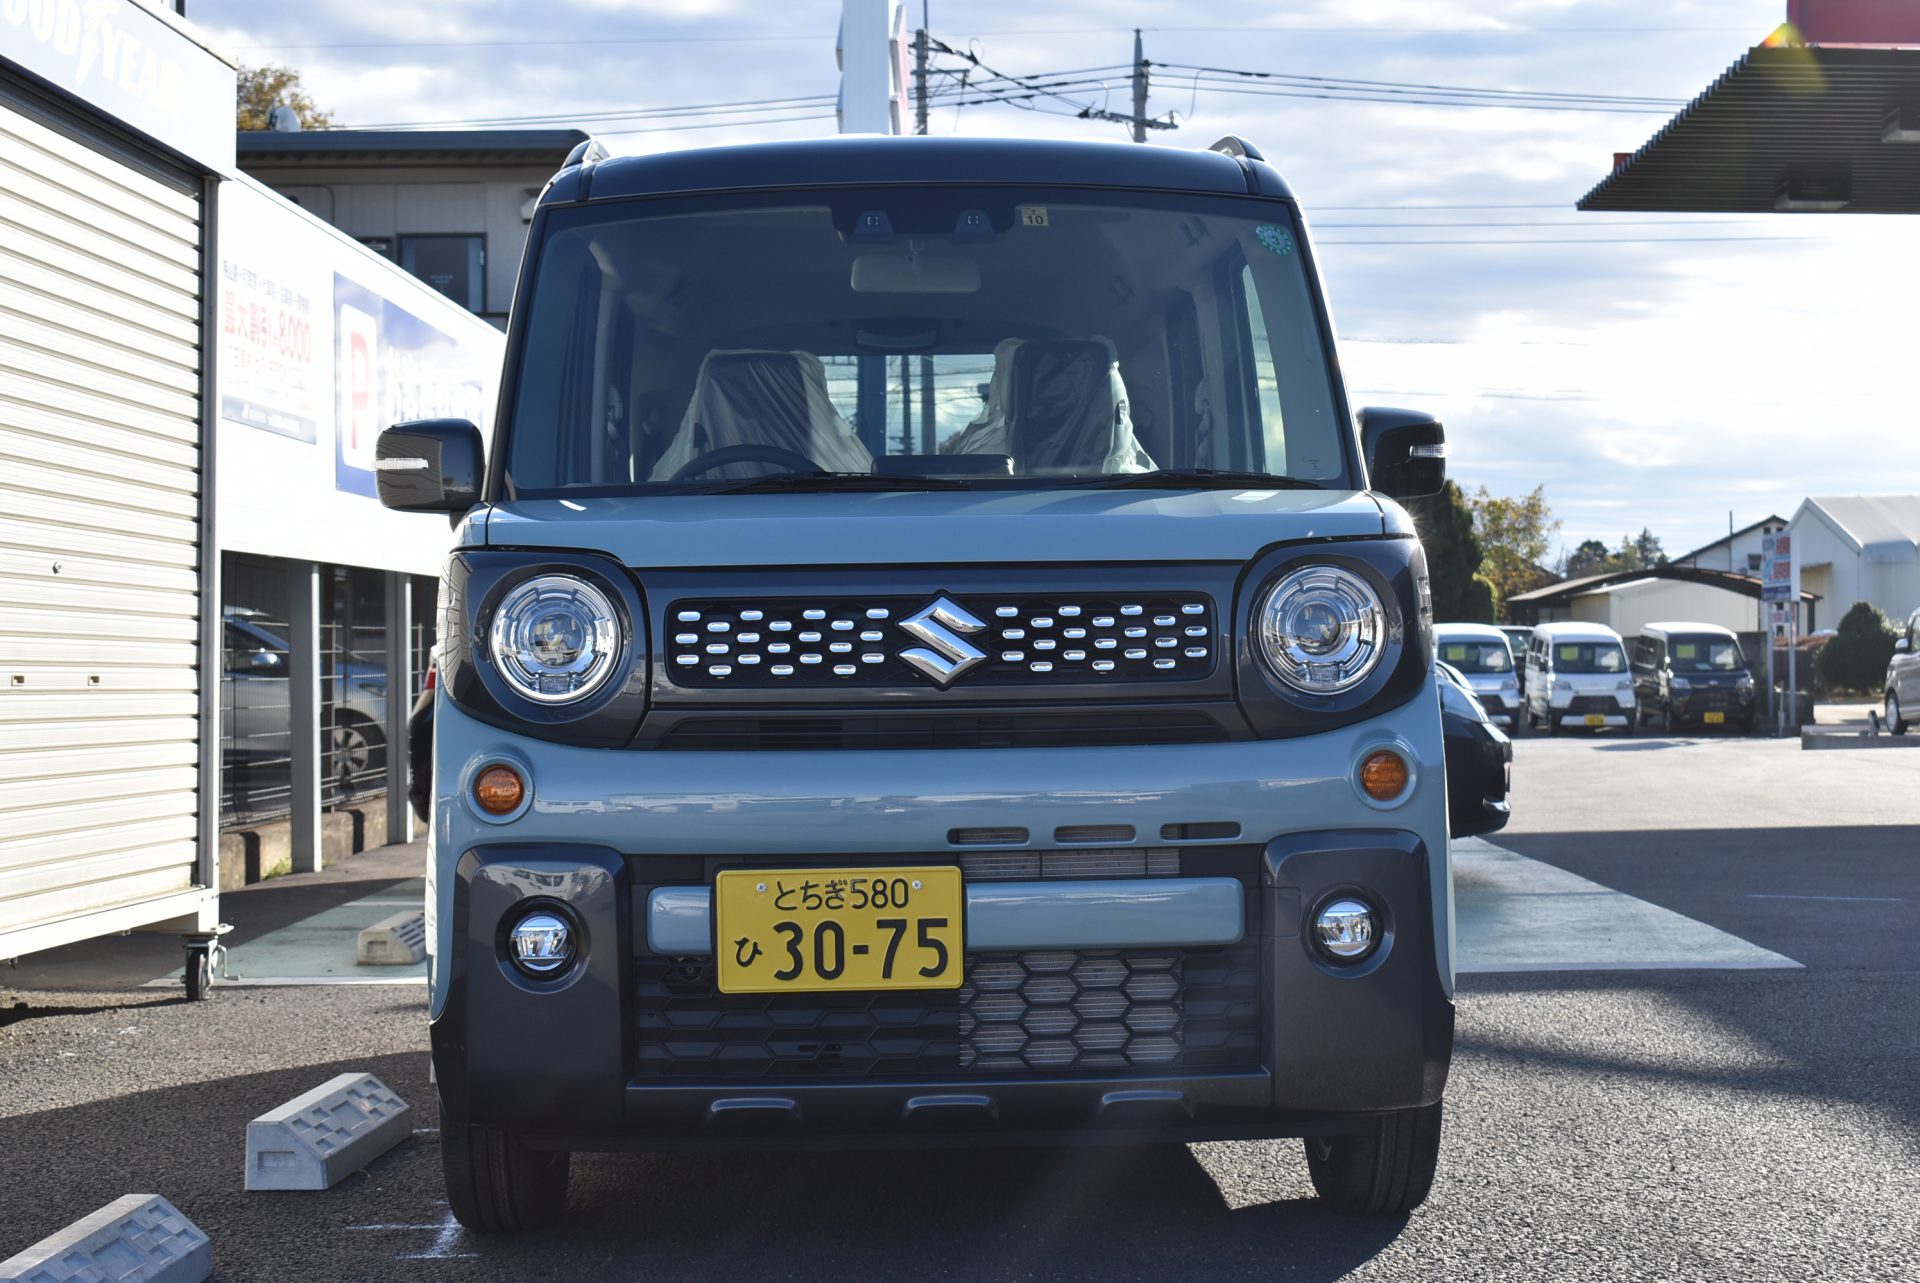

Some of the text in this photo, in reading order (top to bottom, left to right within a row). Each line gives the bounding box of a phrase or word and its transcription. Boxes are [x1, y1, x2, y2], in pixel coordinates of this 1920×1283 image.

[1026, 215, 1044, 225] 10
[350, 330, 370, 450] P
[734, 918, 949, 981] ひ 30-75
